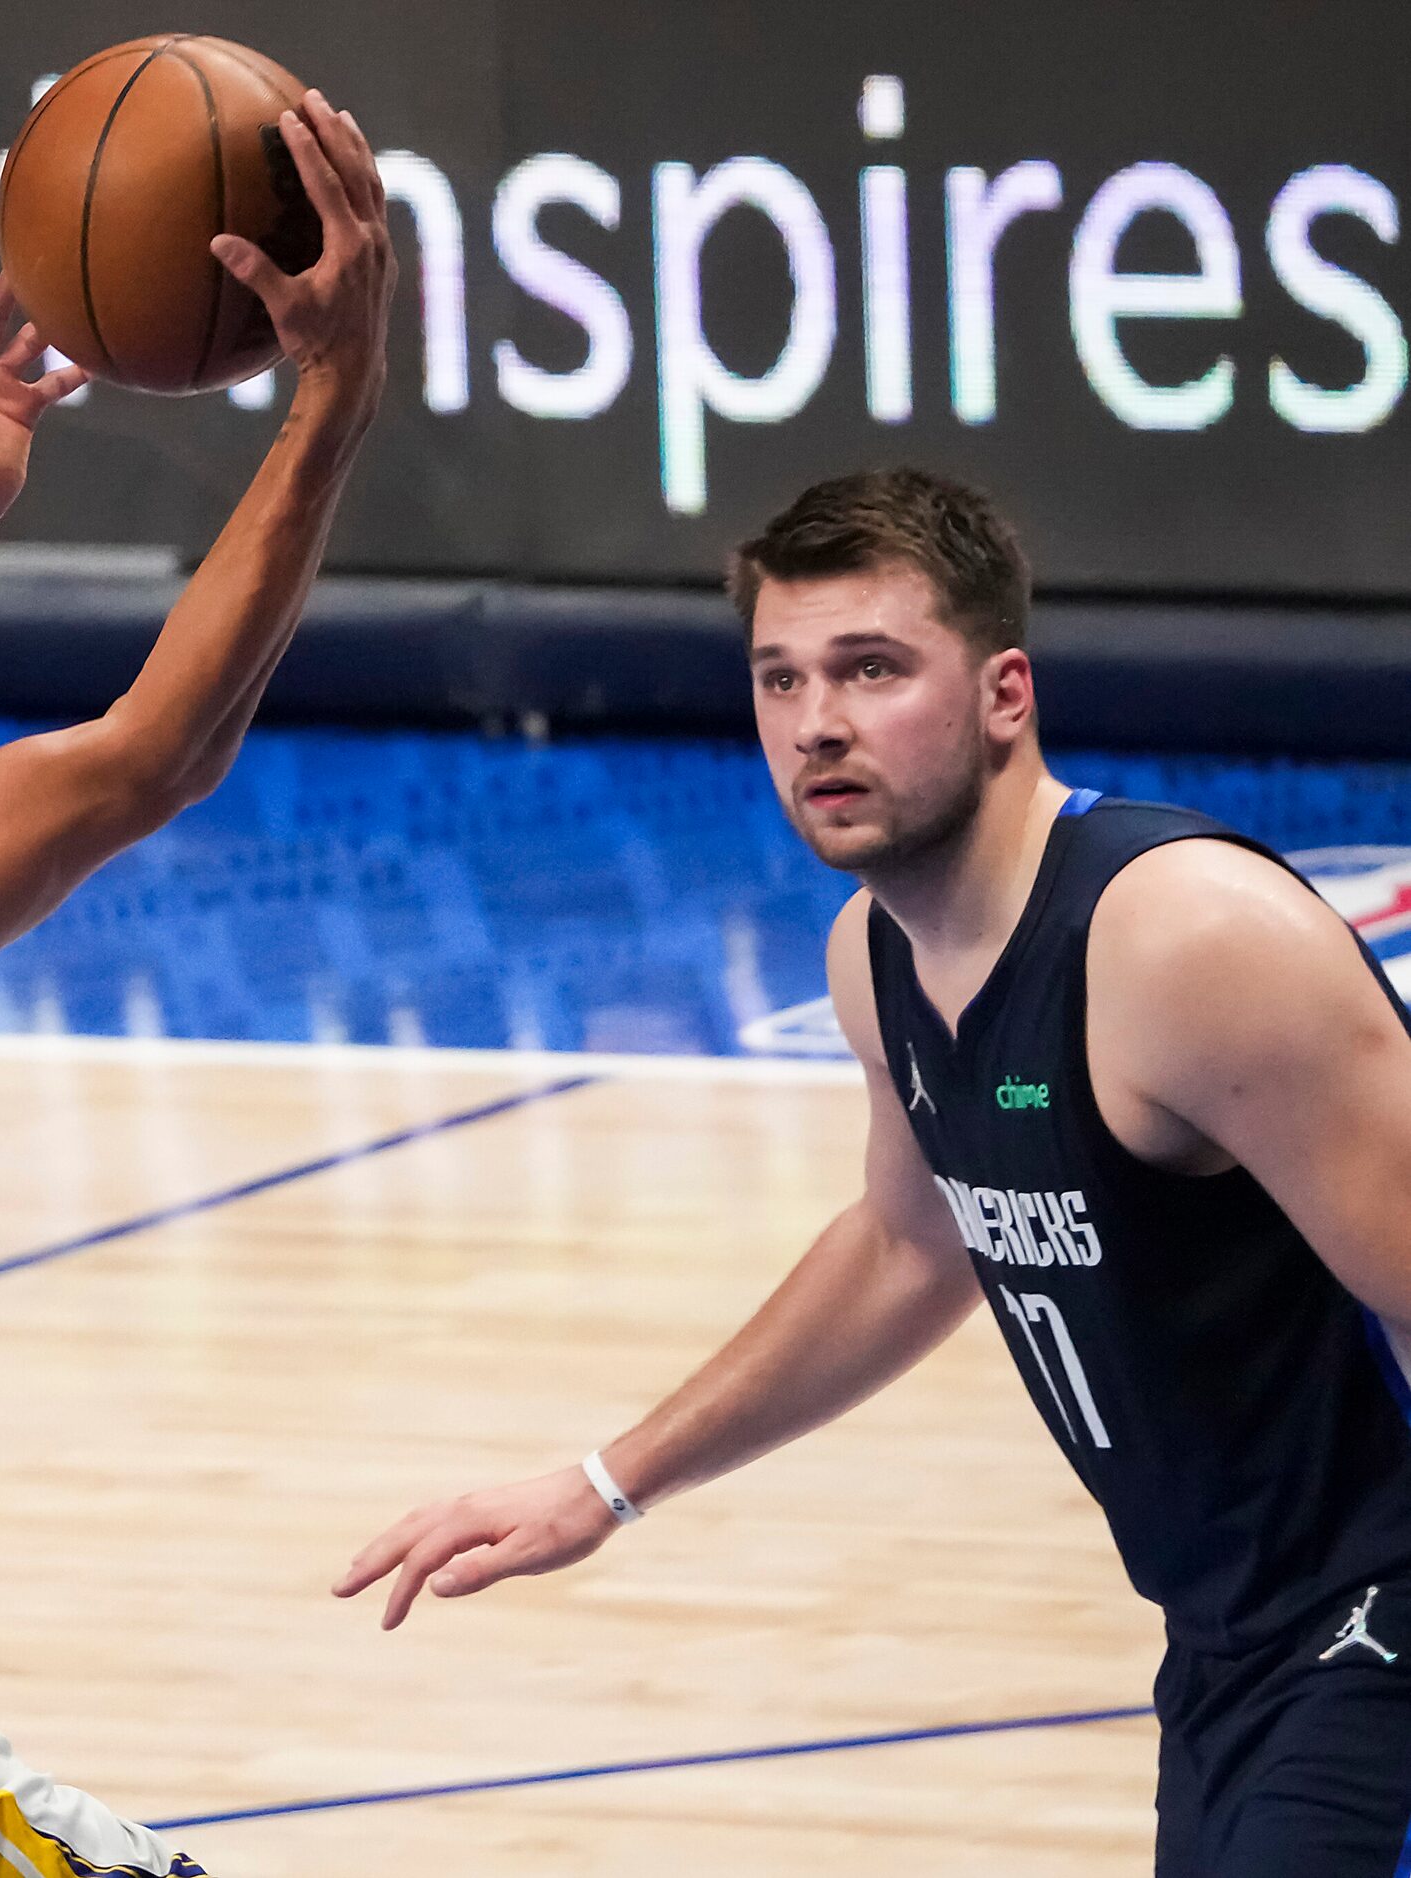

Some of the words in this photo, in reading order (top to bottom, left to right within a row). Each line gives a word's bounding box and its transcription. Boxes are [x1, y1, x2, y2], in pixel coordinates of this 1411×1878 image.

[228, 74, 1410, 515] nspires
[995, 1075, 1050, 1110] chime
[999, 1284, 1112, 1449] 17
